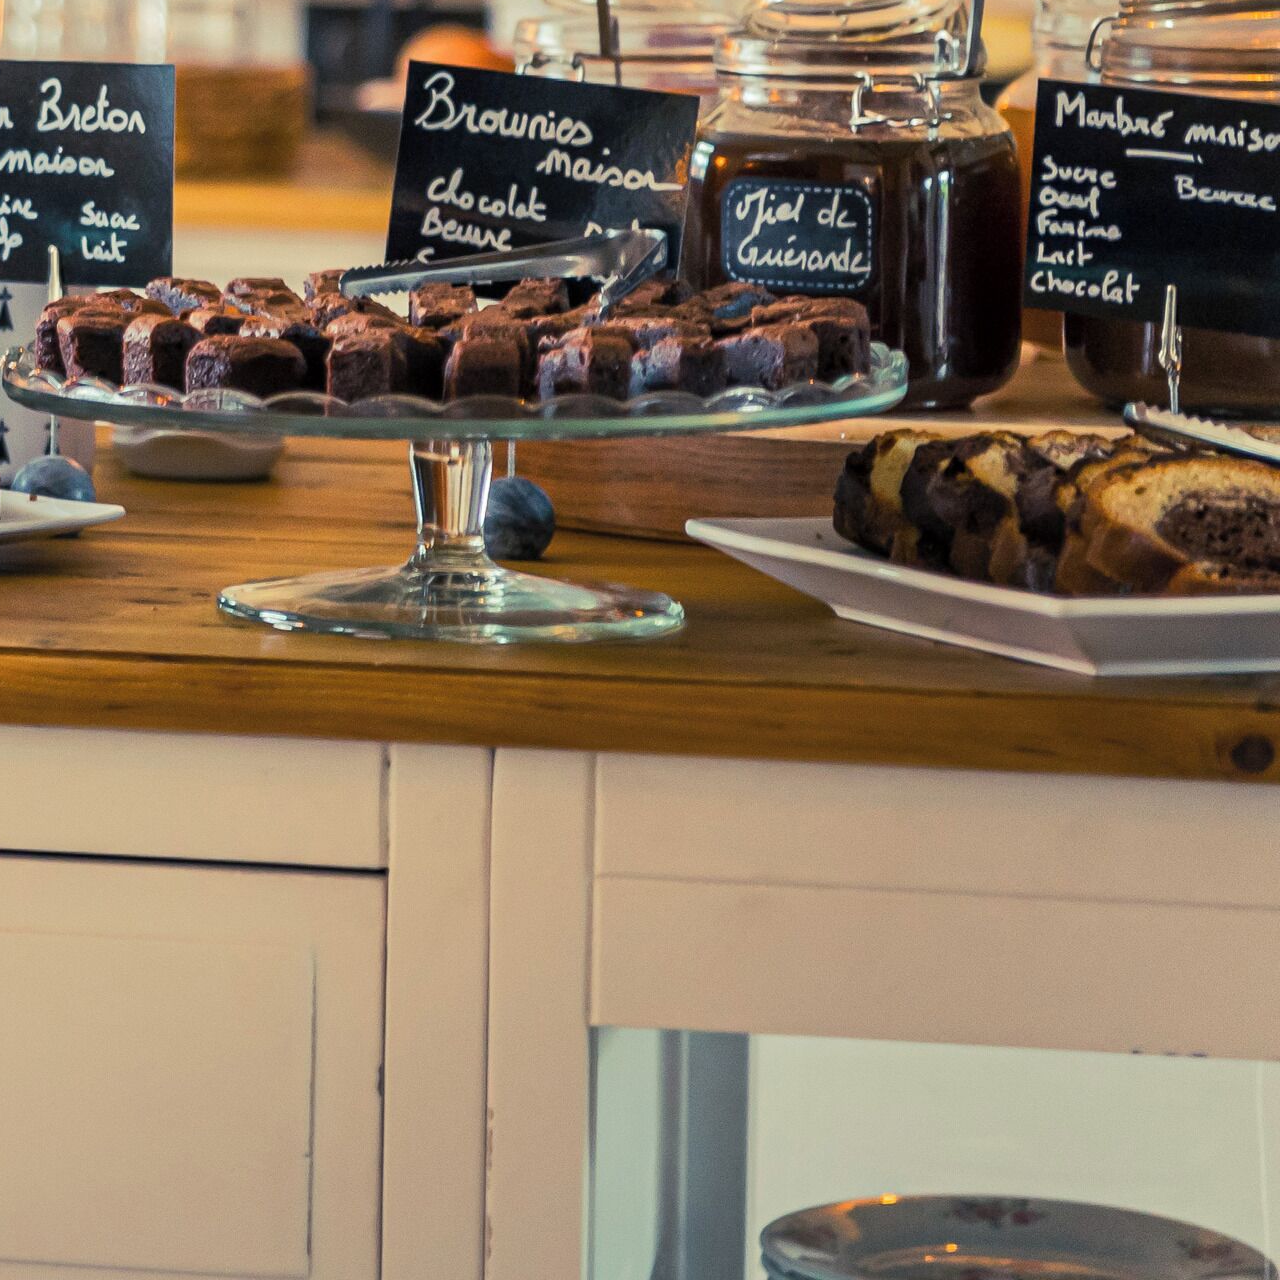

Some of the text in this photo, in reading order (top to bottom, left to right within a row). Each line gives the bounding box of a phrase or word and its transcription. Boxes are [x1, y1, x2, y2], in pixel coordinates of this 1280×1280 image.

[37, 78, 145, 134] Breton
[415, 72, 592, 146] Brownies
[1056, 91, 1280, 151] Marbré maiso
[1042, 155, 1117, 189] Sucre
[1175, 176, 1276, 210] Beurre
[421, 207, 513, 251] Beurre
[736, 188, 856, 237] Miel de
[737, 232, 871, 273] Guérande
